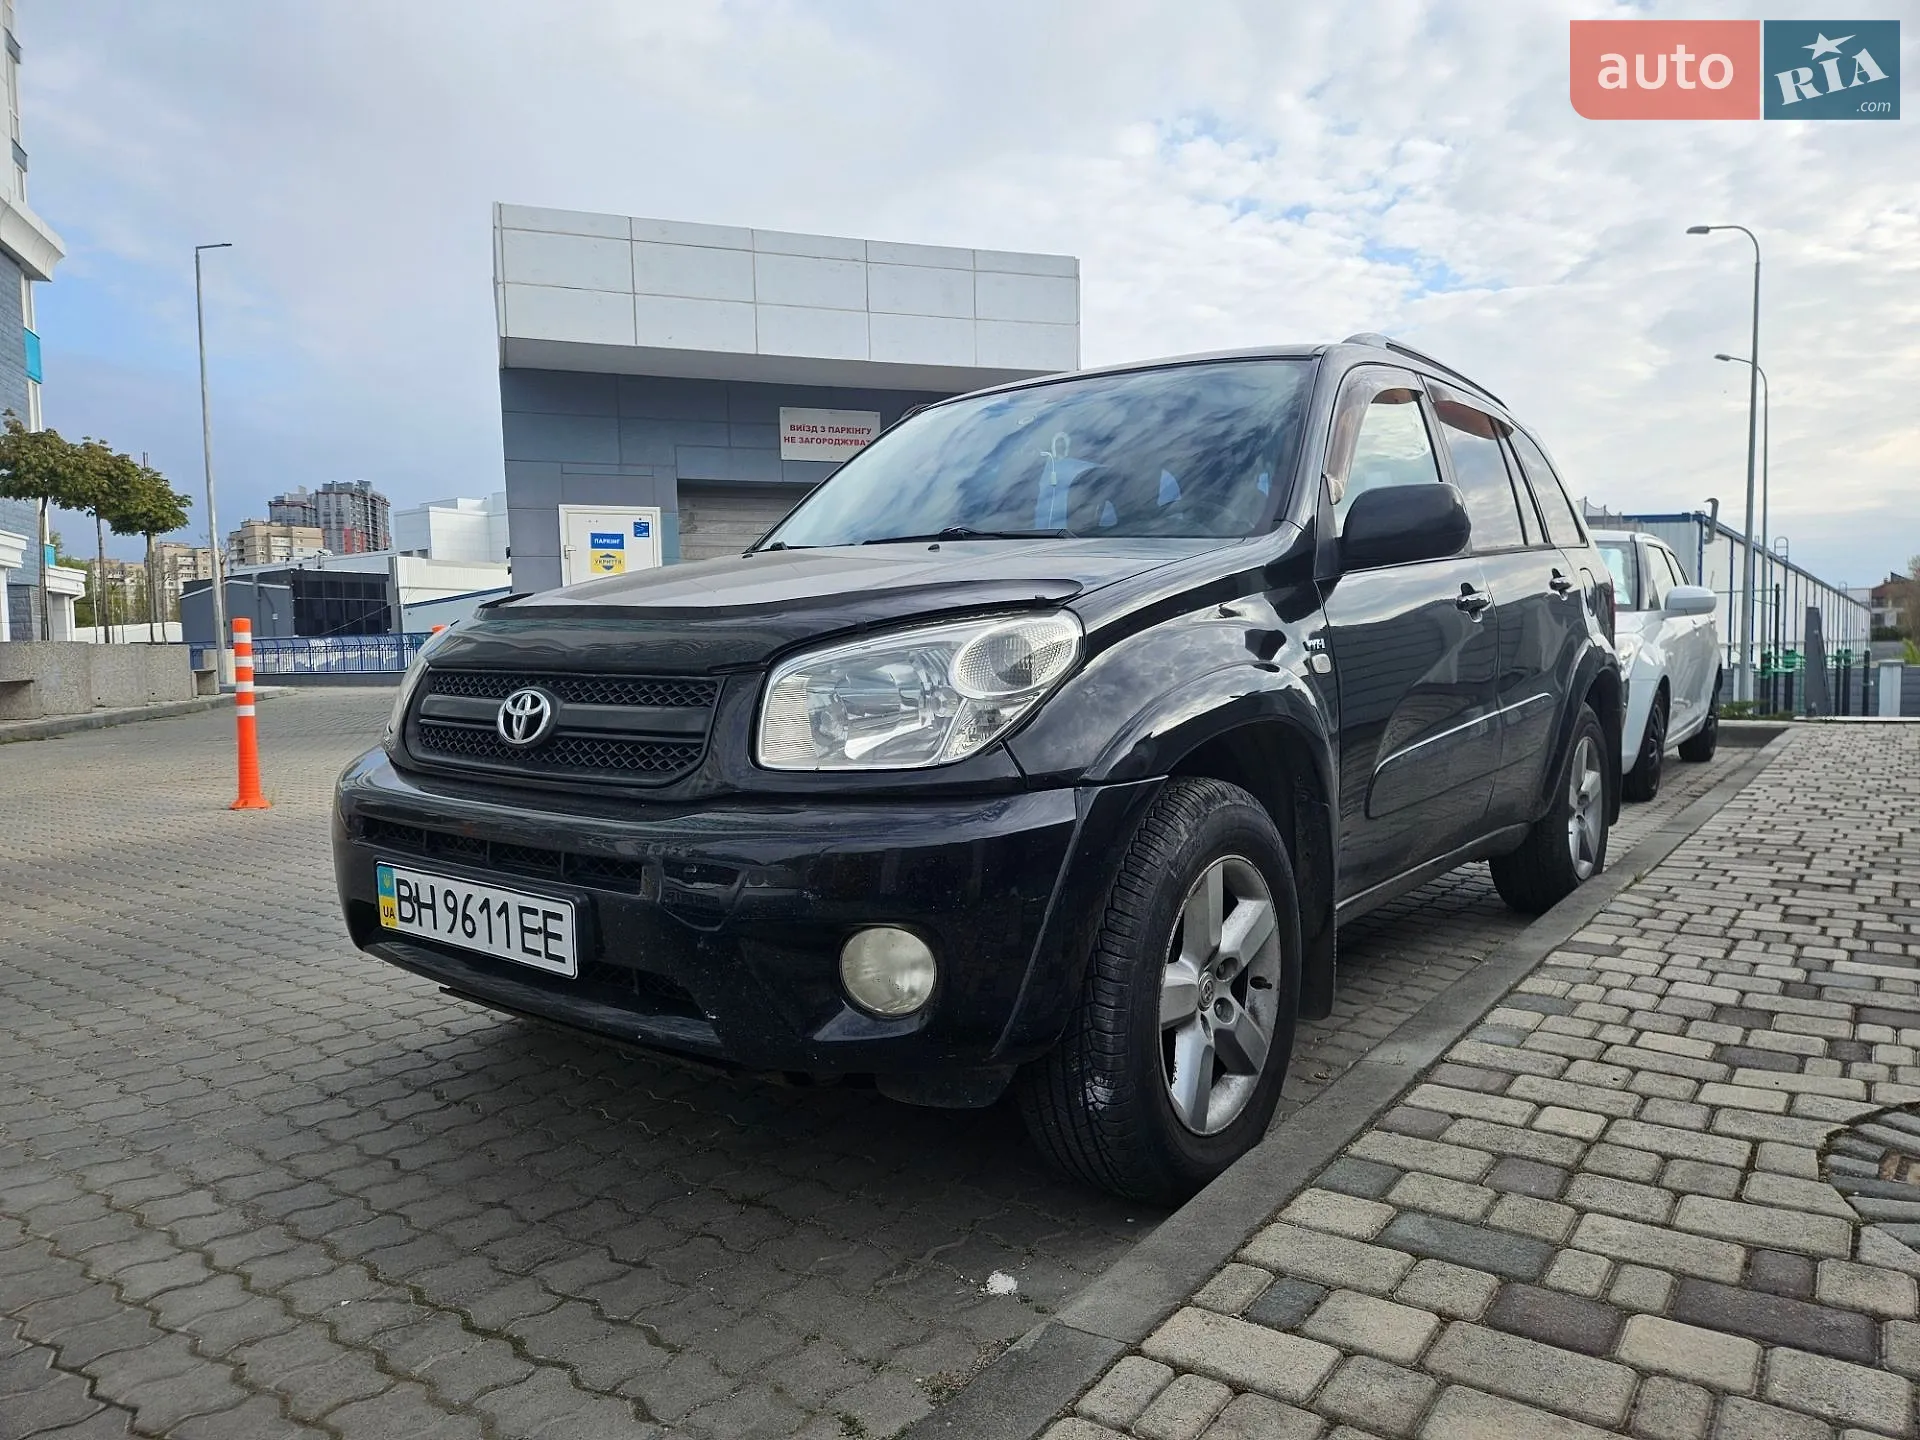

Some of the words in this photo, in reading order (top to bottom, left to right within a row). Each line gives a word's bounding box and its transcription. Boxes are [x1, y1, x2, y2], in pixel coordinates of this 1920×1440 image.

[789, 424, 818, 434] ВИЇЗД
[828, 426, 872, 435] ПАРКІНГУ
[783, 436, 796, 444] НЕ
[383, 904, 396, 920] UA
